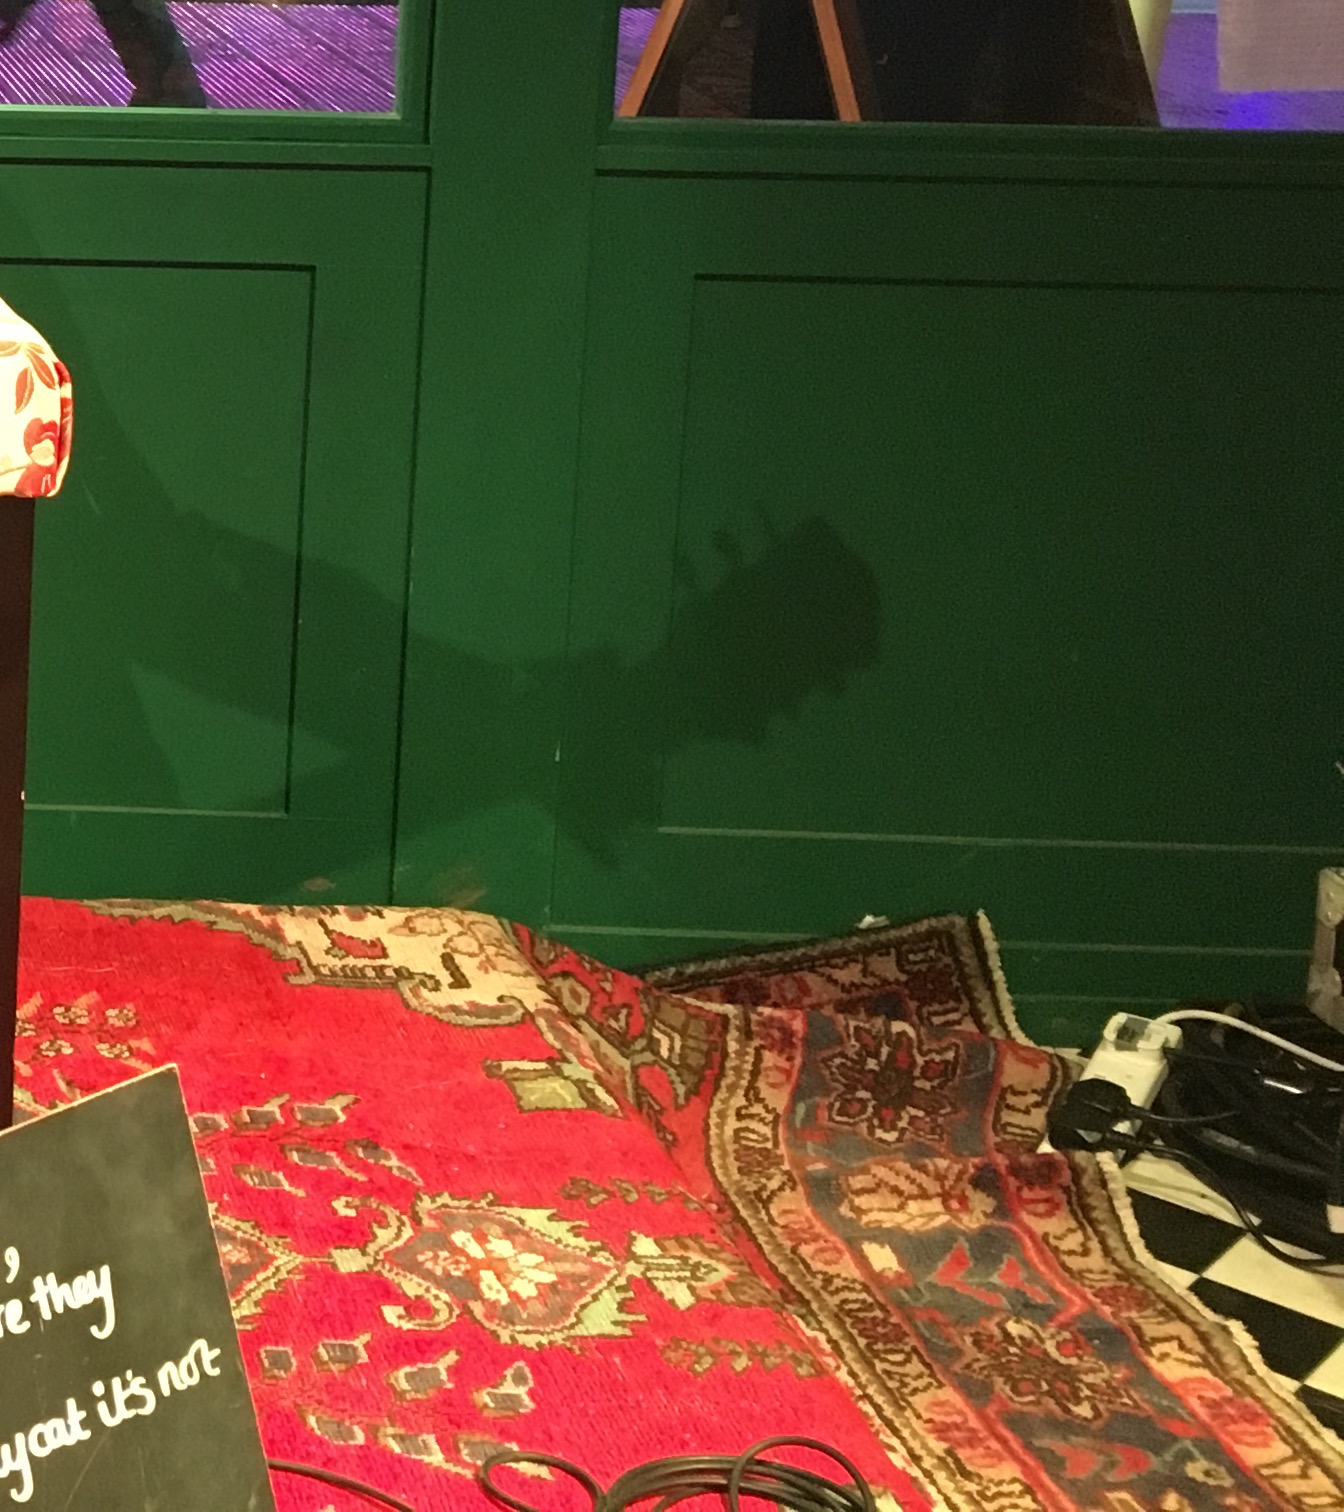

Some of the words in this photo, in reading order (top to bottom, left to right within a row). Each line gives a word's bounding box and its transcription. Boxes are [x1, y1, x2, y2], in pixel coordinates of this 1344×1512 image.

[30, 1264, 116, 1339] they
[92, 1369, 156, 1427] it's
[157, 1338, 221, 1397] not
